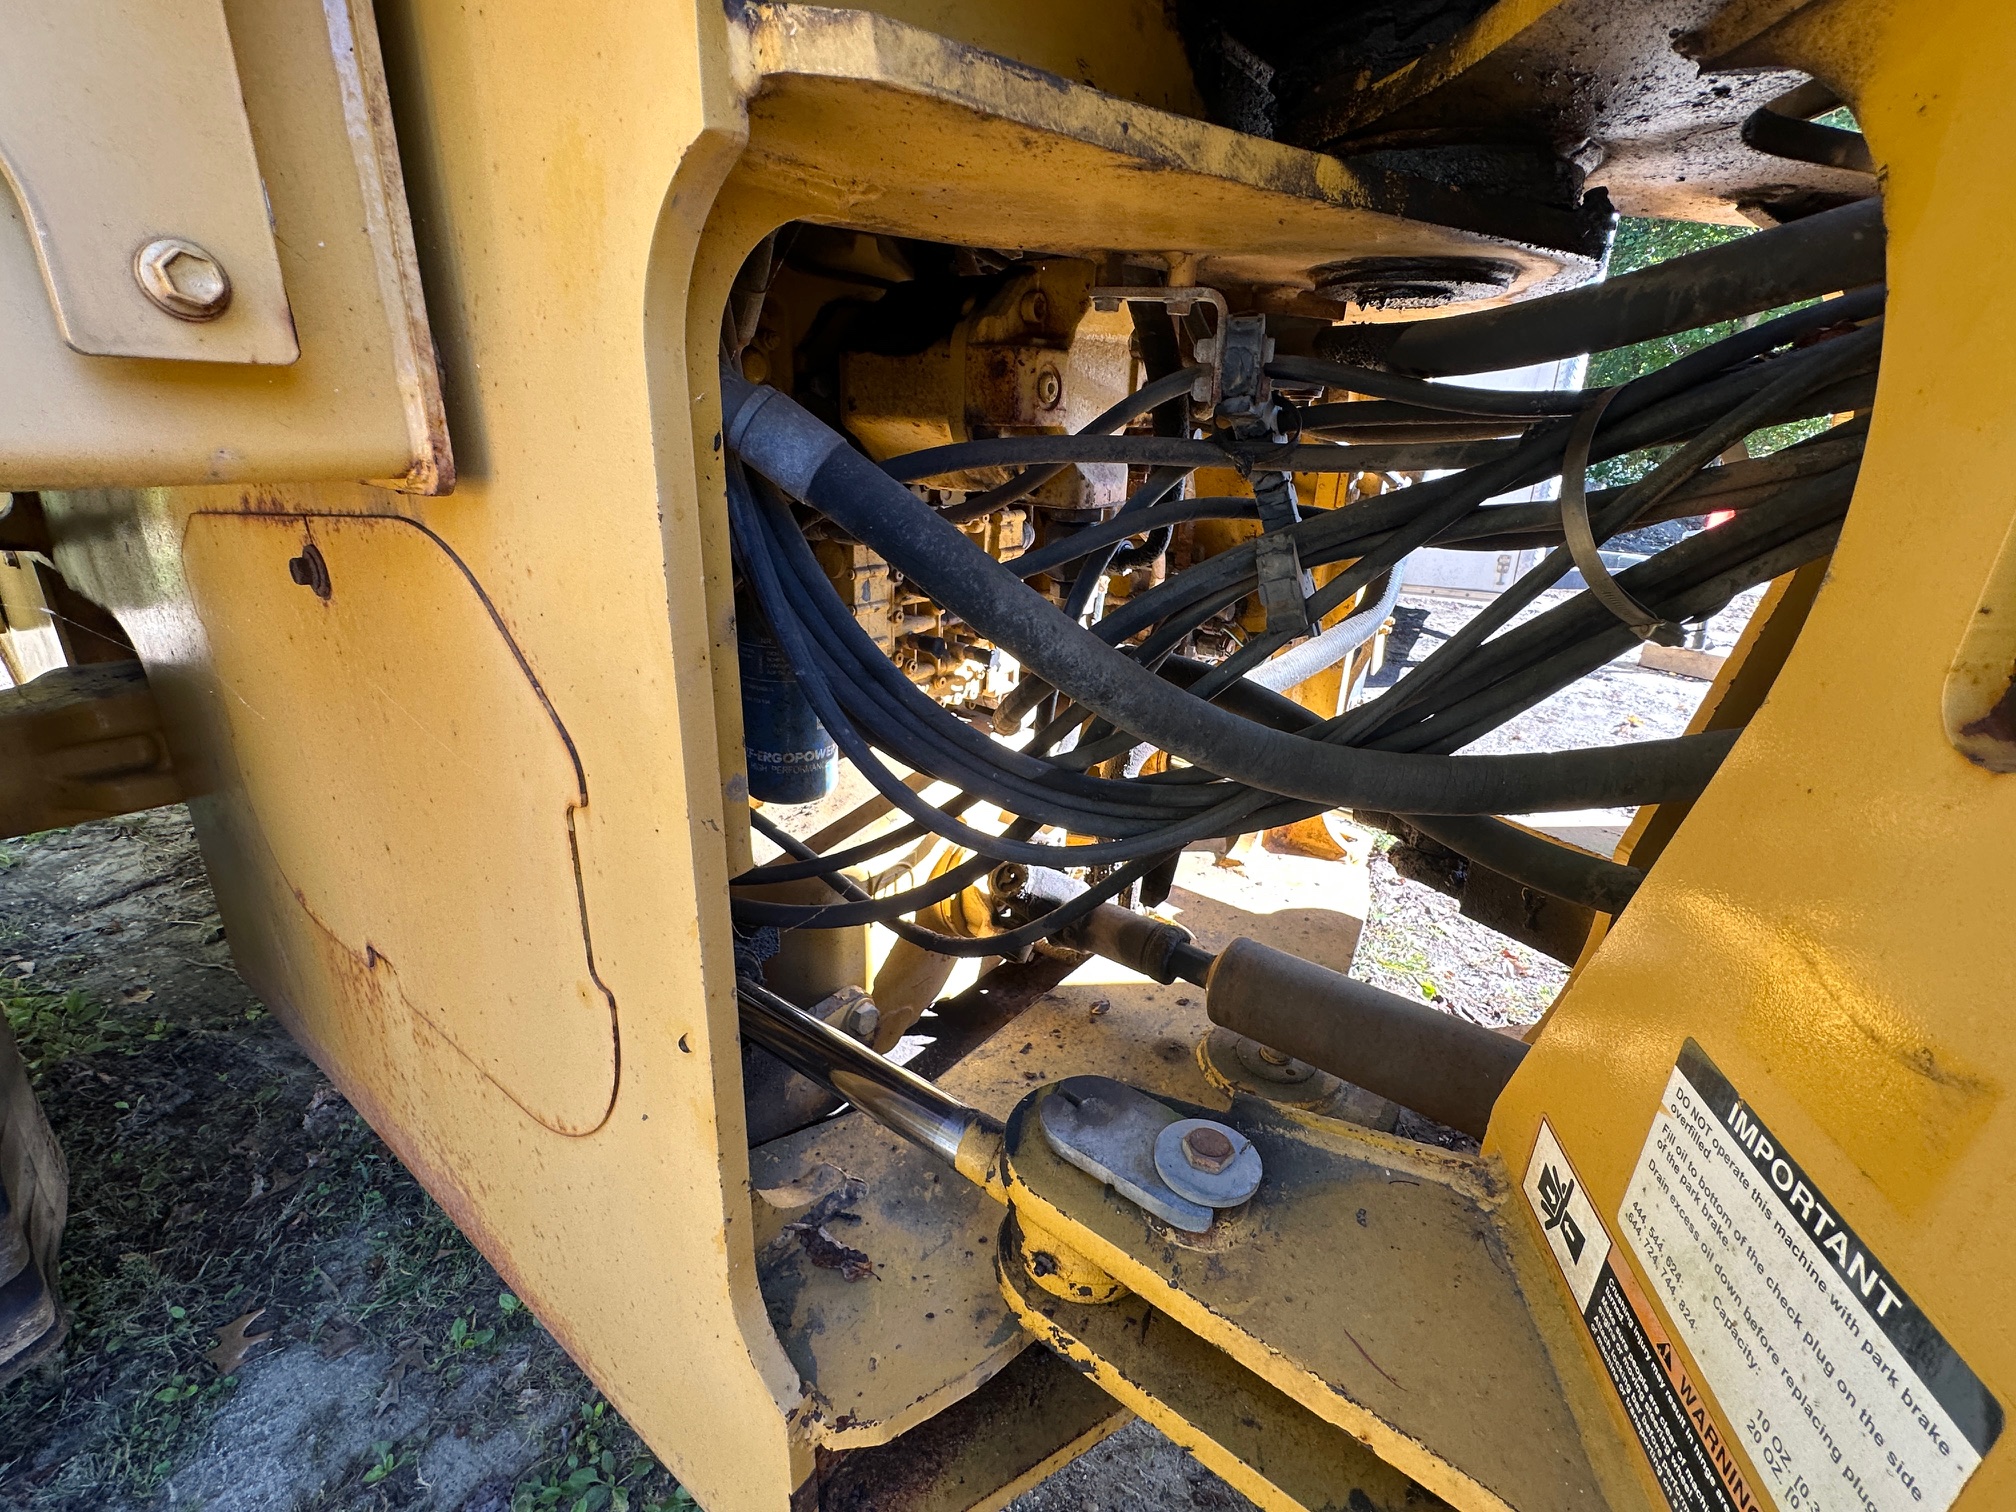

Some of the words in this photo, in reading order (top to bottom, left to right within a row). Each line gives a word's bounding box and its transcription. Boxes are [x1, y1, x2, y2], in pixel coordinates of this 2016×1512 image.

[1657, 1139, 1667, 1153] of
[1666, 1151, 1680, 1174] the
[1679, 1174, 1701, 1206] park
[1701, 1203, 1730, 1252] brake.
[1670, 1104, 1712, 1163] overfilled.
[1727, 1102, 1903, 1317] IMPORTANT
[1605, 1286, 1624, 1325] turned.
[1648, 1158, 1670, 1195] Drain
[1669, 1194, 1700, 1242] excess
[1700, 1242, 1715, 1263] oil
[1714, 1263, 1742, 1308] down
[1743, 1306, 1780, 1366] before
[1781, 1367, 1842, 1464] replacing
[1842, 1465, 1878, 1512] plug
[1662, 1123, 1676, 1146] Fill
[1676, 1145, 1688, 1163] oil
[1687, 1161, 1697, 1178] to
[1698, 1175, 1733, 1229] bottom
[1733, 1229, 1748, 1247] of
[1746, 1246, 1764, 1275] the
[1766, 1276, 1803, 1330] check
[1803, 1331, 1835, 1378] plug
[1837, 1379, 1857, 1408] on
[1859, 1408, 1885, 1447] the
[1887, 1451, 1922, 1502] side
[1666, 1255, 1684, 1289] 624:
[1757, 1408, 1770, 1433] 10
[1772, 1435, 1791, 1474] OZ.
[1676, 1087, 1690, 1109] DO
[1691, 1106, 1713, 1136] NOT
[1712, 1138, 1750, 1190] operate
[1751, 1188, 1772, 1220] this
[1774, 1220, 1827, 1293] machine
[1830, 1294, 1860, 1338] with
[1861, 1339, 1899, 1389] park
[1901, 1387, 1950, 1456] brake
[1713, 1296, 1761, 1376] Capacity:
[1591, 1323, 1598, 1334] of
[1597, 1336, 1619, 1382] machine
[1619, 1384, 1626, 1395] or
[1626, 1397, 1663, 1477] transporting
[1663, 1477, 1672, 1497] on
[1672, 1498, 1678, 1509] a
[1593, 1316, 1611, 1350] Attach
[1610, 1349, 1632, 1394] locking
[1631, 1392, 1643, 1414] bar
[1642, 1414, 1662, 1458] before
[1598, 1306, 1616, 1342] engine
[1616, 1343, 1623, 1354] or
[1622, 1356, 1645, 1402] moving
[1644, 1402, 1671, 1456] steering
[1671, 1454, 1693, 1503] wheel.
[1601, 1296, 1615, 1325] Make
[1616, 1326, 1629, 1351] sure
[1628, 1352, 1649, 1392] people
[1649, 1394, 1660, 1414] are
[1660, 1416, 1677, 1448] clear
[1677, 1451, 1686, 1466] of
[1685, 1468, 1710, 1512] machi
[1609, 1278, 1634, 1328] Crushing
[1633, 1326, 1651, 1361] injury
[1651, 1362, 1666, 1388] may
[1665, 1390, 1686, 1428] result
[1685, 1427, 1694, 1444] in
[1694, 1443, 1716, 1486] hinge
[1679, 1299, 1698, 1334] 824:
[1746, 1419, 1762, 1443] 20
[1763, 1446, 1782, 1485] OZ.
